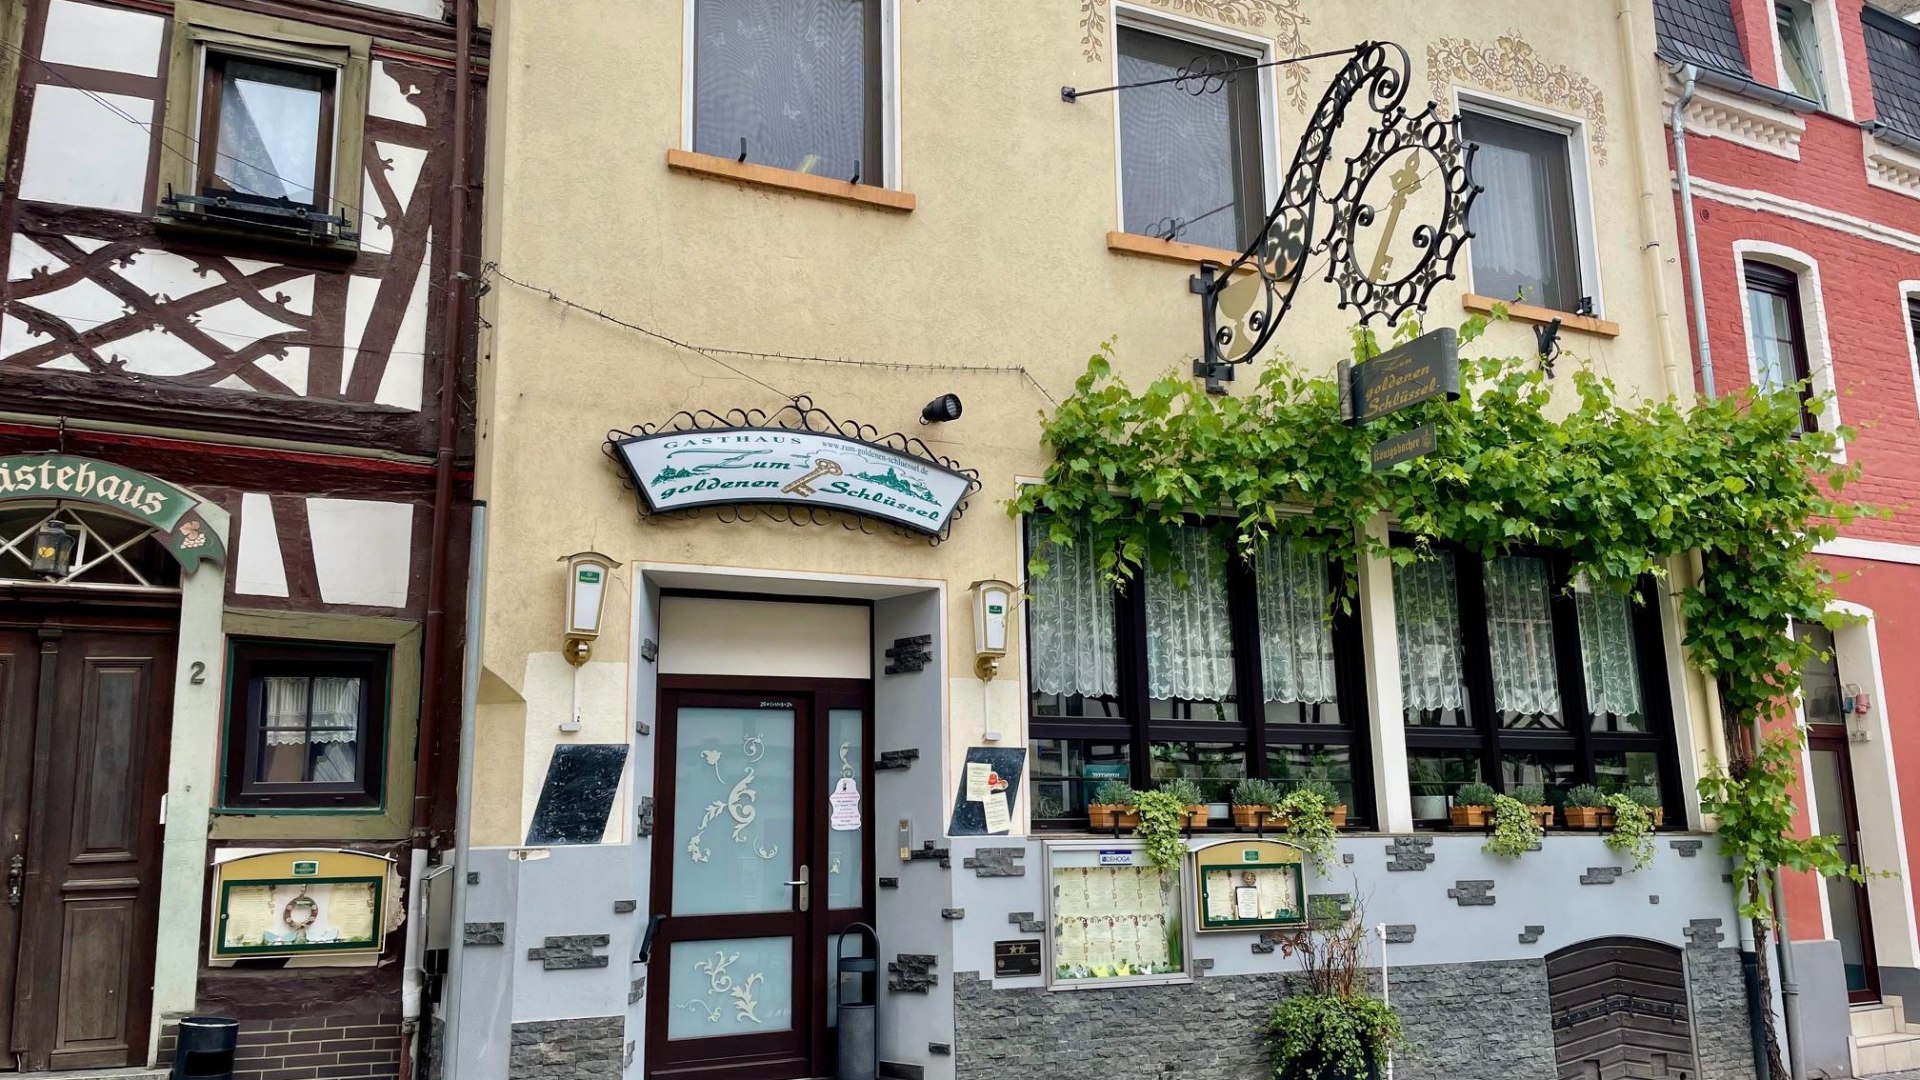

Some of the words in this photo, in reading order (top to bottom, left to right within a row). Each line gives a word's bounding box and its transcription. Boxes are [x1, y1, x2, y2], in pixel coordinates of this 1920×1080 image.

[1363, 376, 1436, 418] Schlüssel
[1365, 365, 1430, 402] goldenen
[663, 435, 802, 449] GASTHAUS
[666, 448, 791, 472] Zum
[821, 440, 929, 476] www.zum-goldenen-schluessel.de
[660, 477, 780, 500] goldenen
[818, 481, 939, 521] Schlüssel
[189, 660, 206, 685] 2
